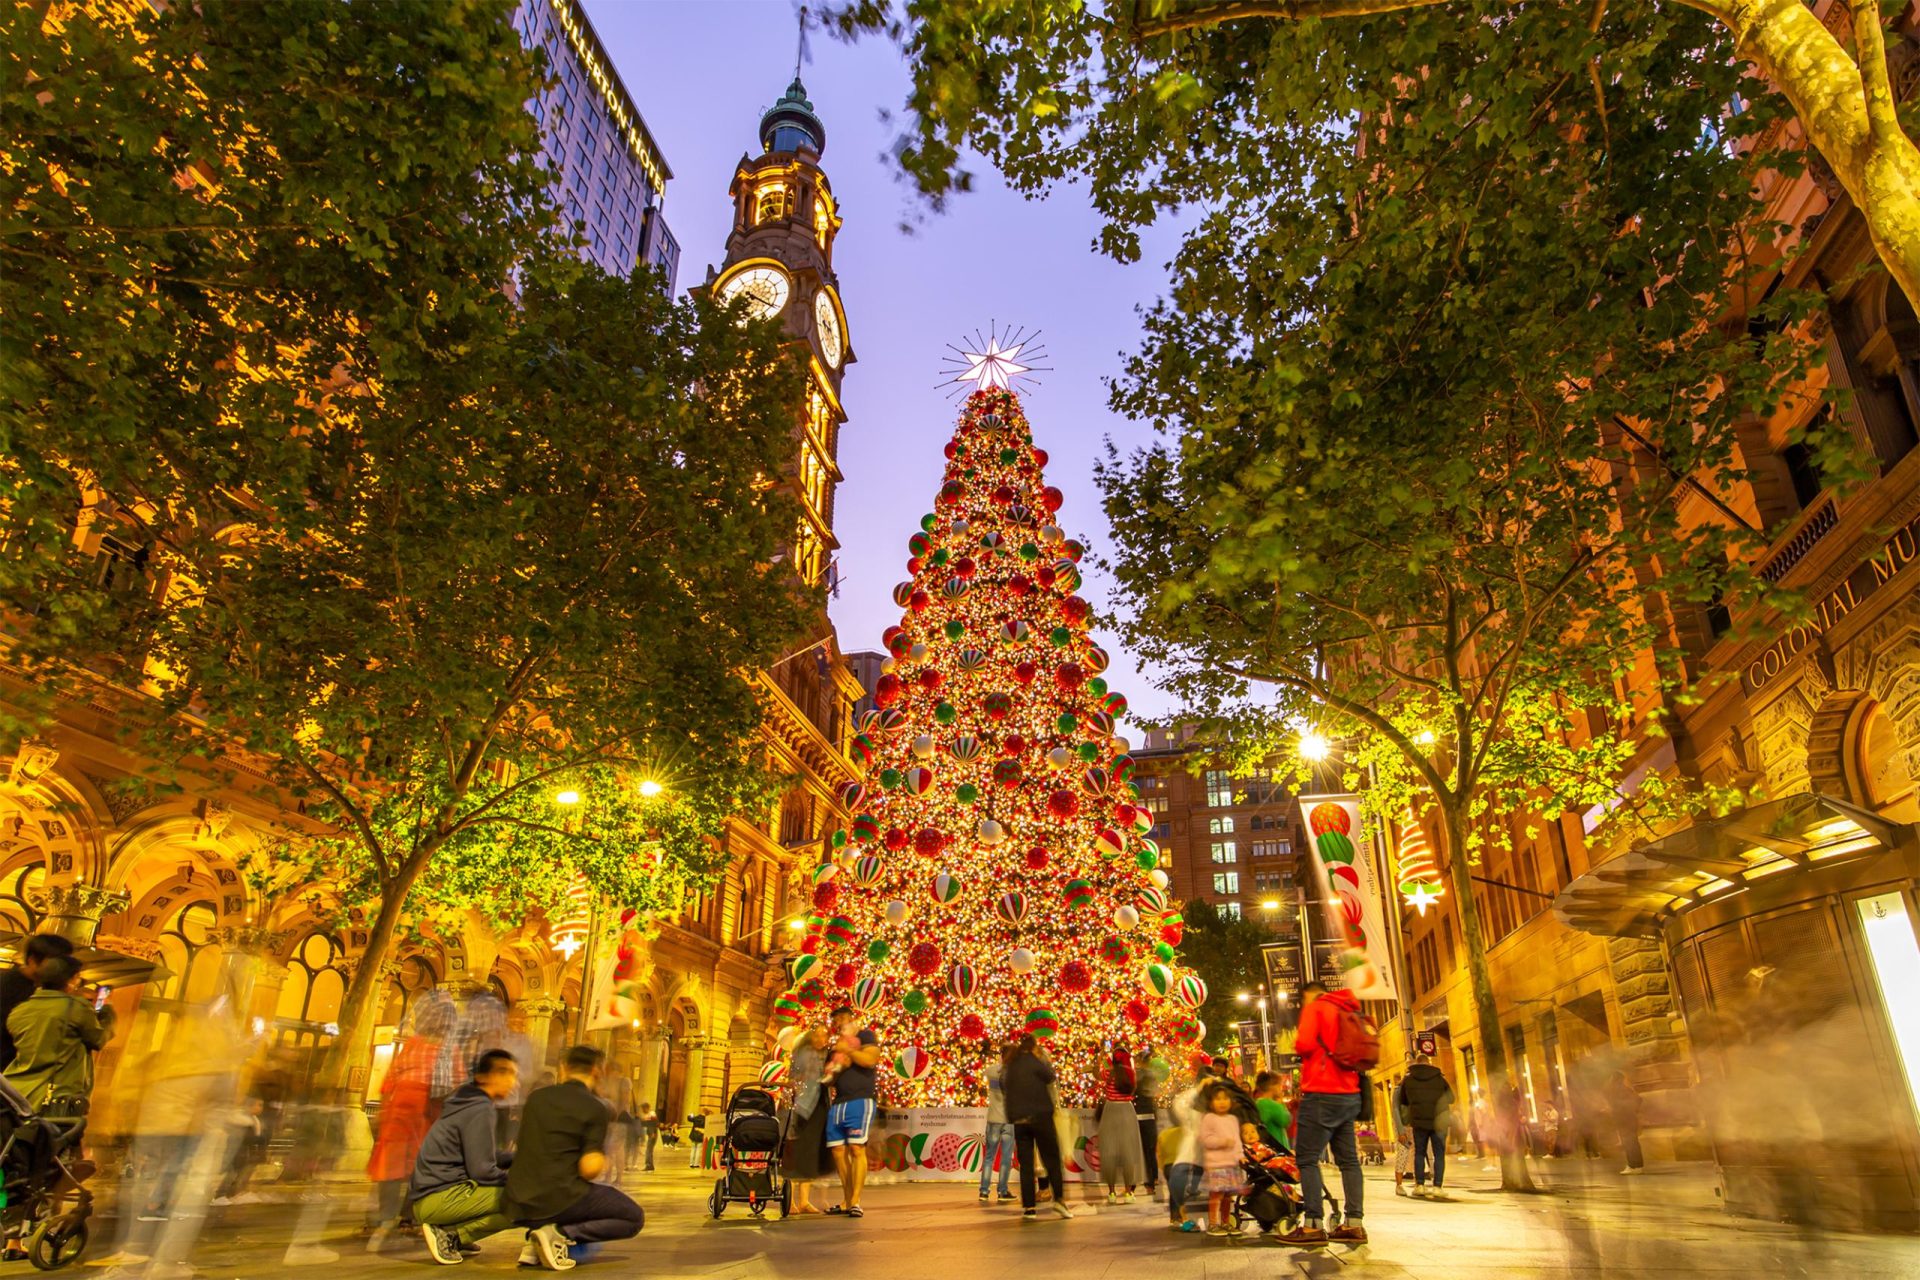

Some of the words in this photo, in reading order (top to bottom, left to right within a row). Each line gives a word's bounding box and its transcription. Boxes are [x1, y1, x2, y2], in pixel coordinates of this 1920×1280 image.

[630, 127, 665, 200] HOTEL
[1750, 579, 1862, 689] COLONIAL
[1870, 515, 1920, 587] MU
